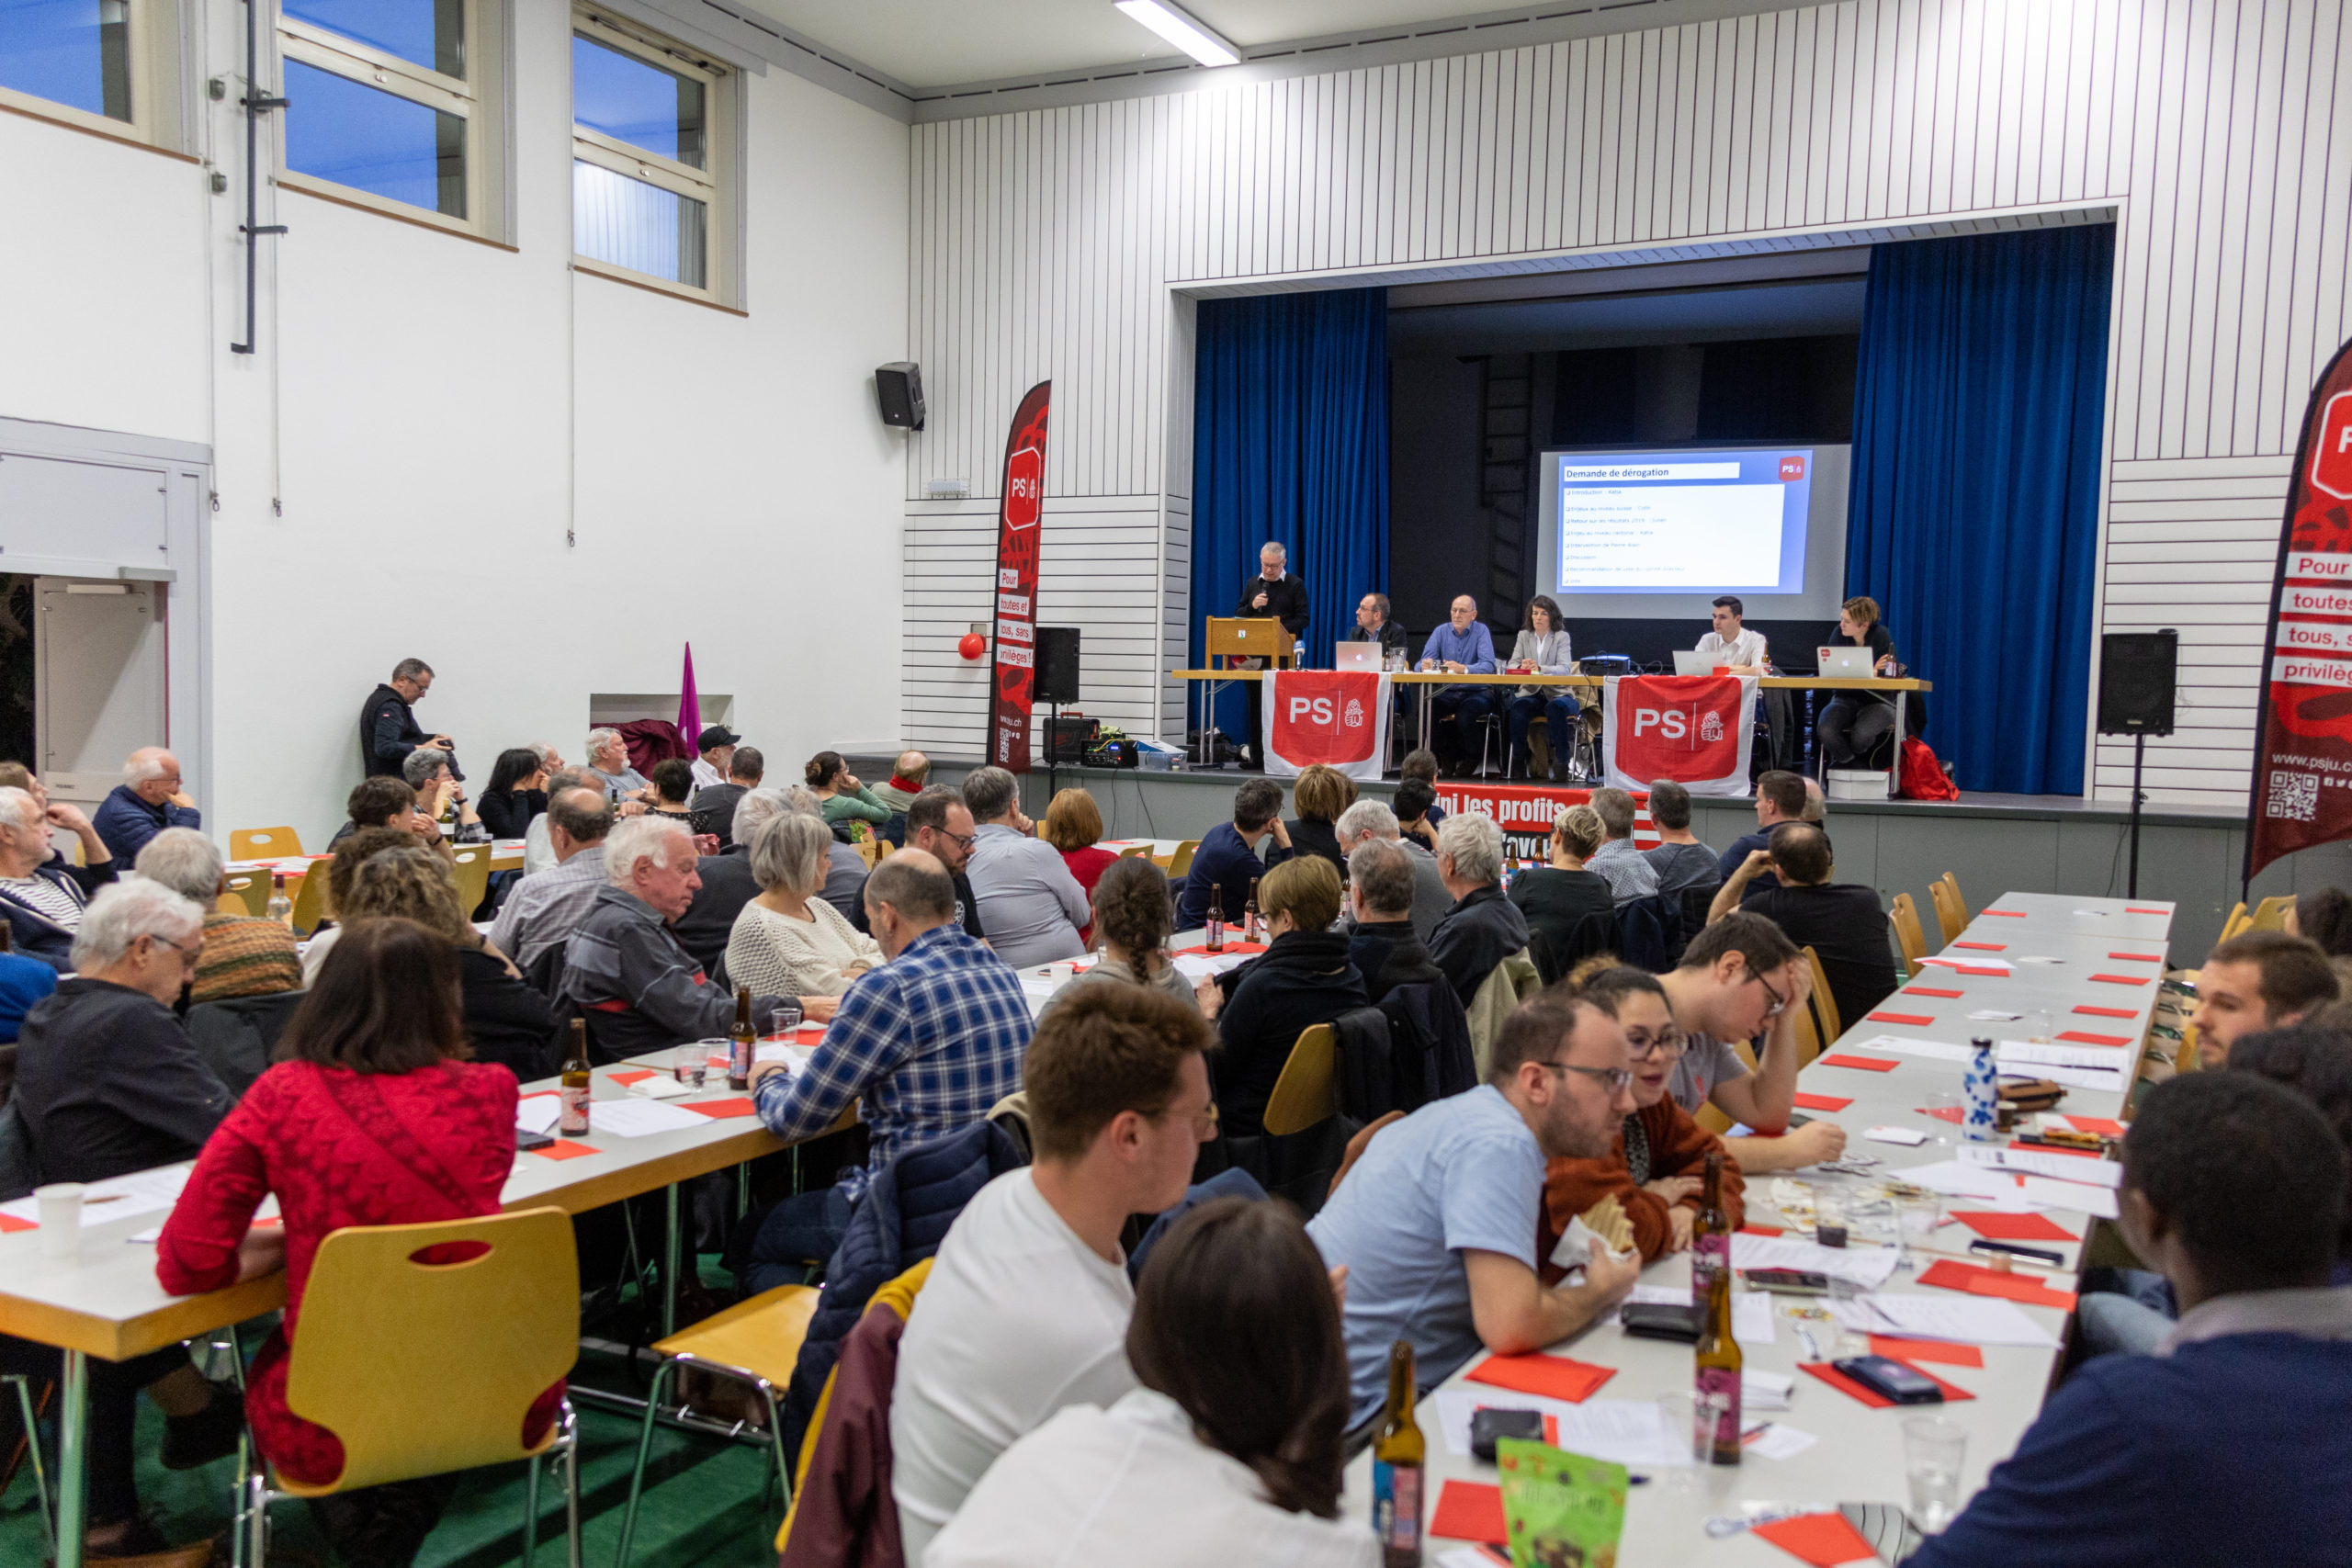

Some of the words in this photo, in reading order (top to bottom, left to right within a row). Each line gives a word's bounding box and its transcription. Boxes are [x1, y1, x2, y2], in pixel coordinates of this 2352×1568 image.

[1566, 469, 1607, 478] Demande
[1609, 469, 1620, 478] de
[1622, 468, 1669, 479] dérogation
[1782, 465, 1794, 473] PS
[1012, 478, 1026, 497] PS
[2299, 558, 2349, 575] Pour
[1001, 572, 1016, 585] Pour
[1001, 598, 1020, 611] toutes
[1021, 600, 1027, 612] et
[1015, 626, 1029, 638] sans
[2289, 627, 2338, 648] tous,
[1289, 697, 1332, 726] PS
[1634, 708, 1686, 739] PS
[2272, 754, 2352, 772] www.psju.c
[1464, 795, 1493, 818] les
[1499, 797, 1566, 824] profits
